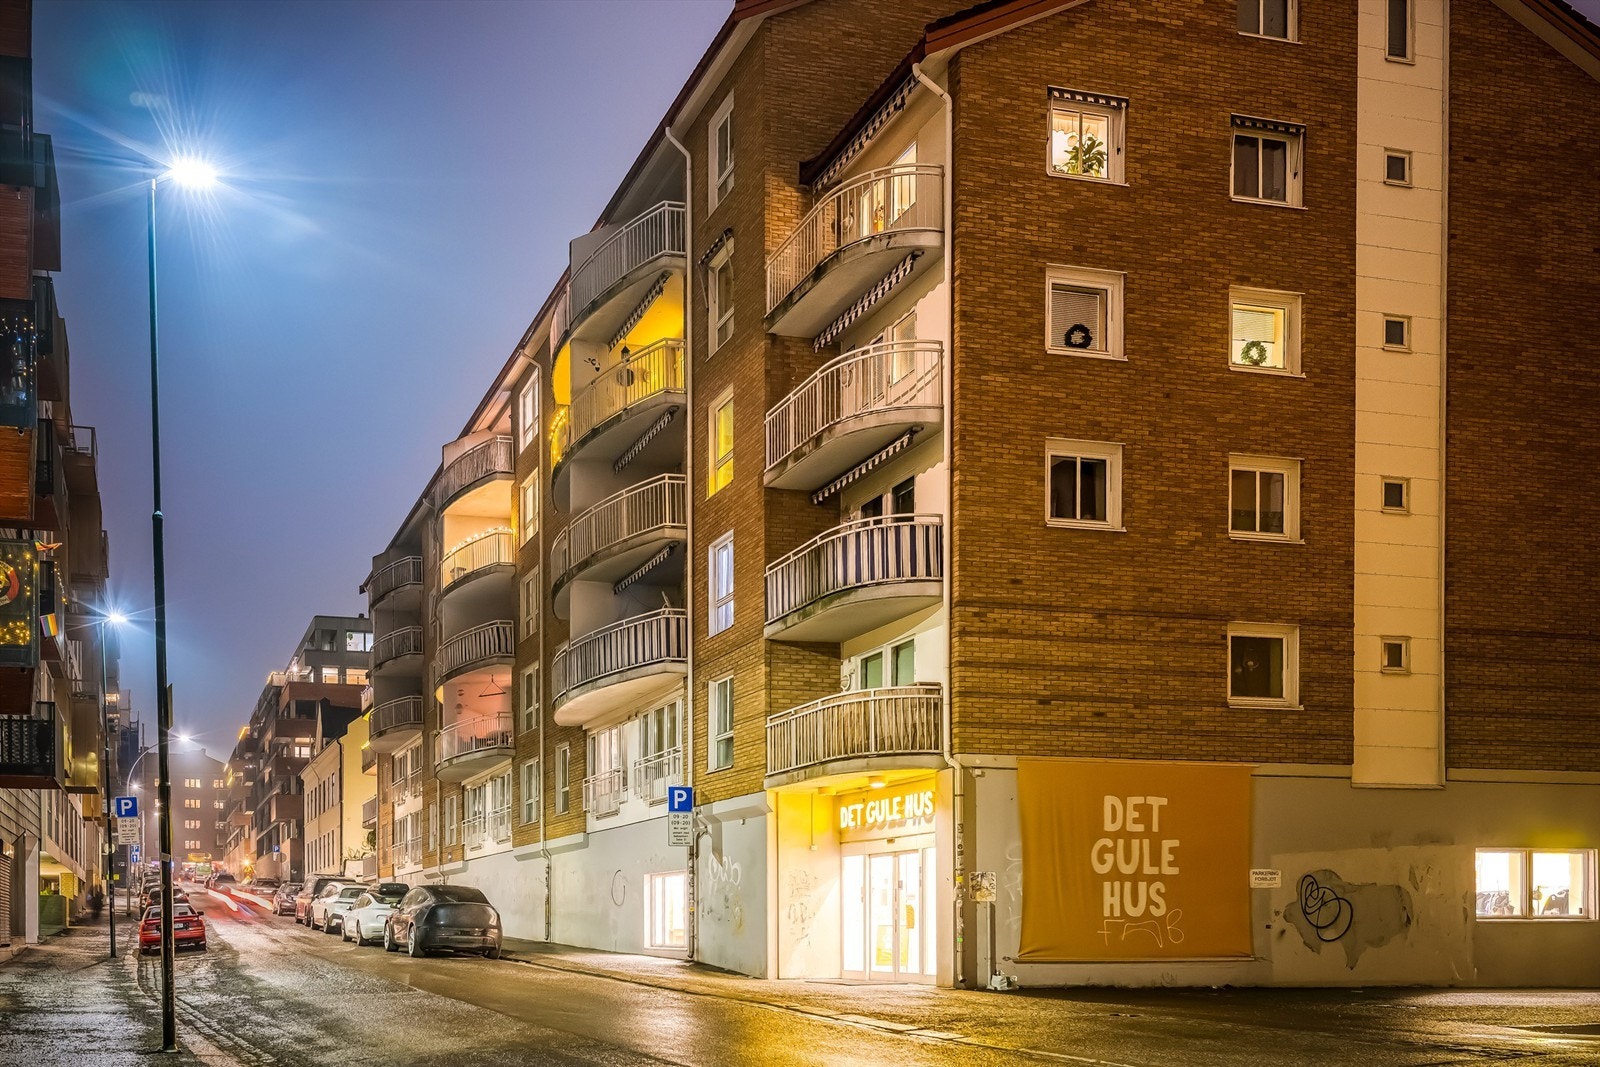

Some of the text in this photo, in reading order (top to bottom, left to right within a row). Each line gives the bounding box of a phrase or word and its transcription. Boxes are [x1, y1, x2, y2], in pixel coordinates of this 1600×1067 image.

[120, 800, 132, 815] P
[674, 790, 687, 809] P
[840, 790, 933, 829] DET GULE HUS
[1103, 795, 1168, 833] DET
[1091, 838, 1180, 875] GULE
[1103, 881, 1167, 917] HUS
